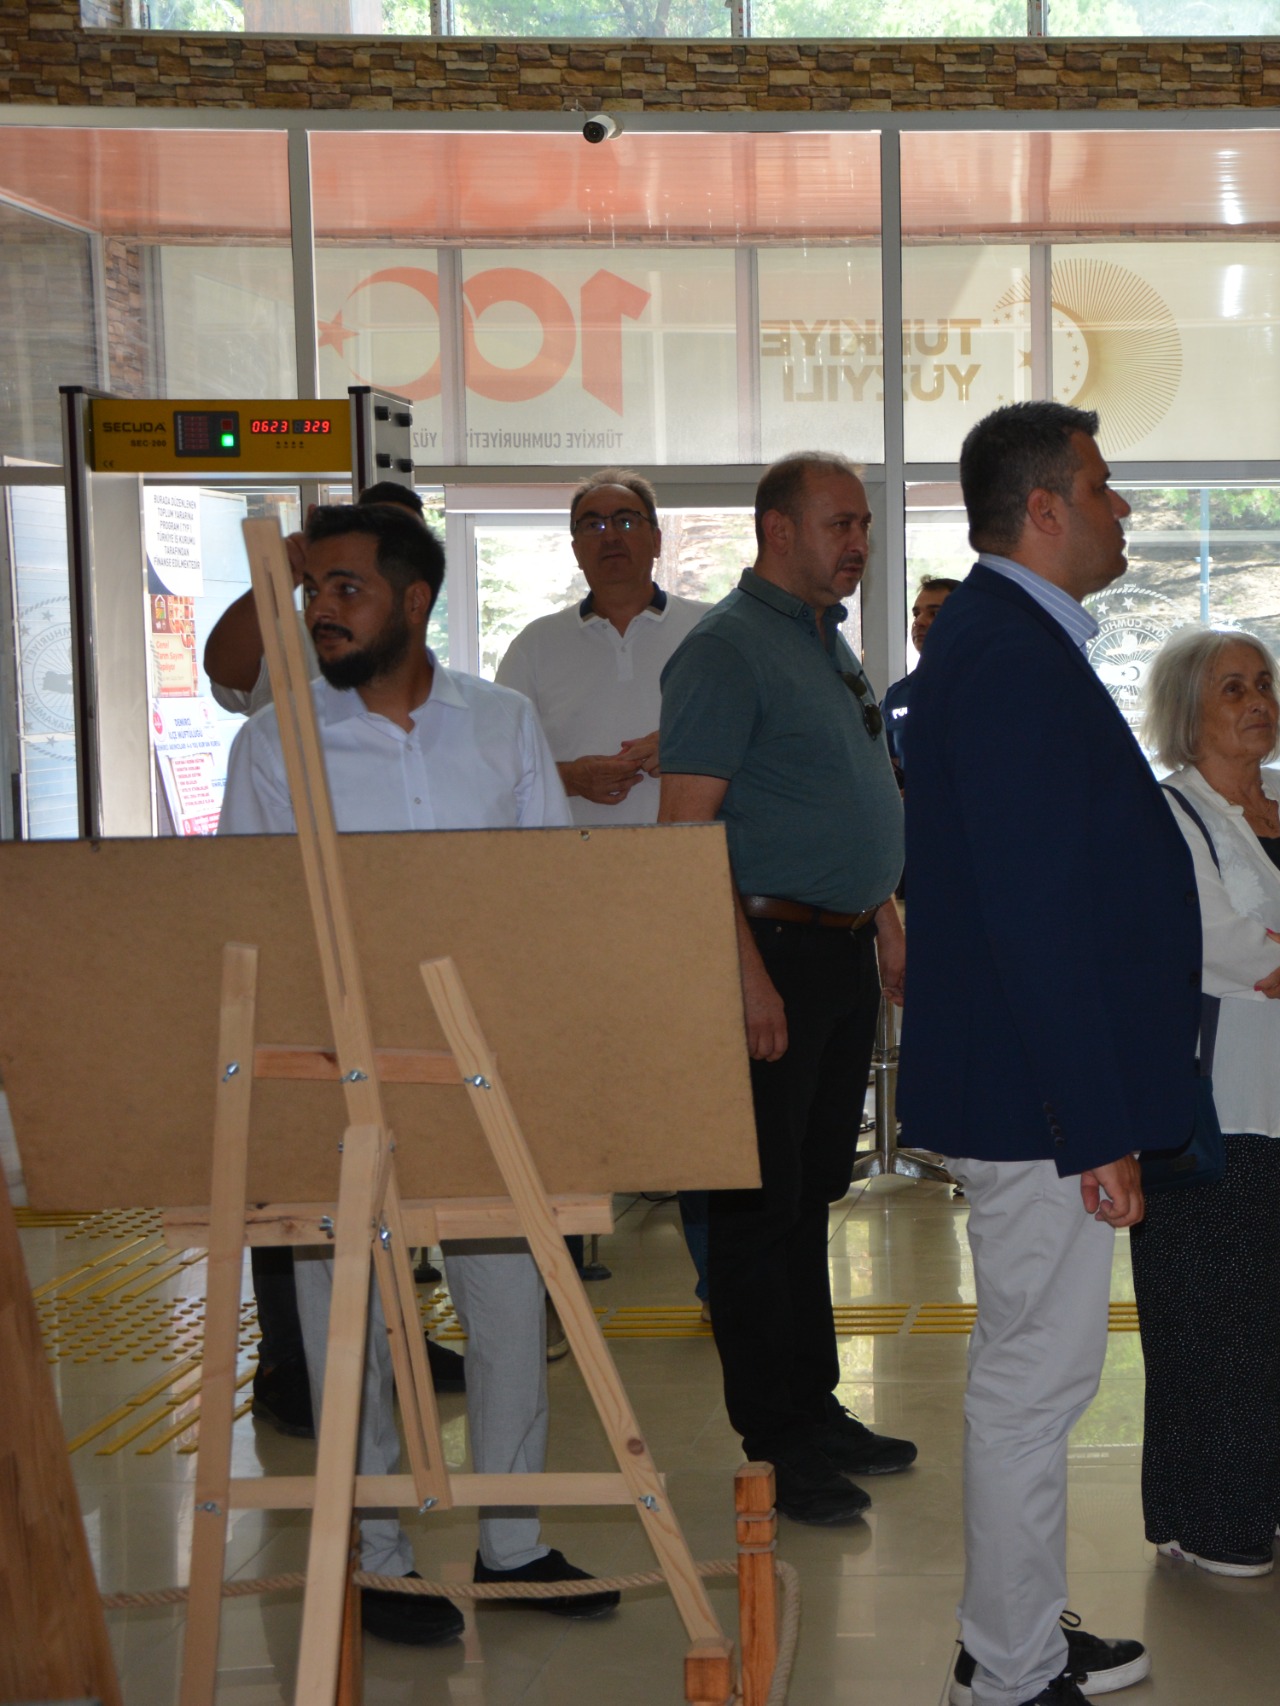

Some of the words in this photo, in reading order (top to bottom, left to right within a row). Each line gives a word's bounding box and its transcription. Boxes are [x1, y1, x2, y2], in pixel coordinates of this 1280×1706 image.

[102, 422, 167, 433] SECUDA
[251, 420, 289, 433] 0623
[303, 420, 330, 433] 329
[153, 494, 171, 506] BURADA
[171, 496, 197, 510] DÜZENLENEN
[157, 507, 174, 518] TOPLUM
[160, 520, 180, 531] PROGRAM
[164, 545, 190, 557] TARAFINDAN
